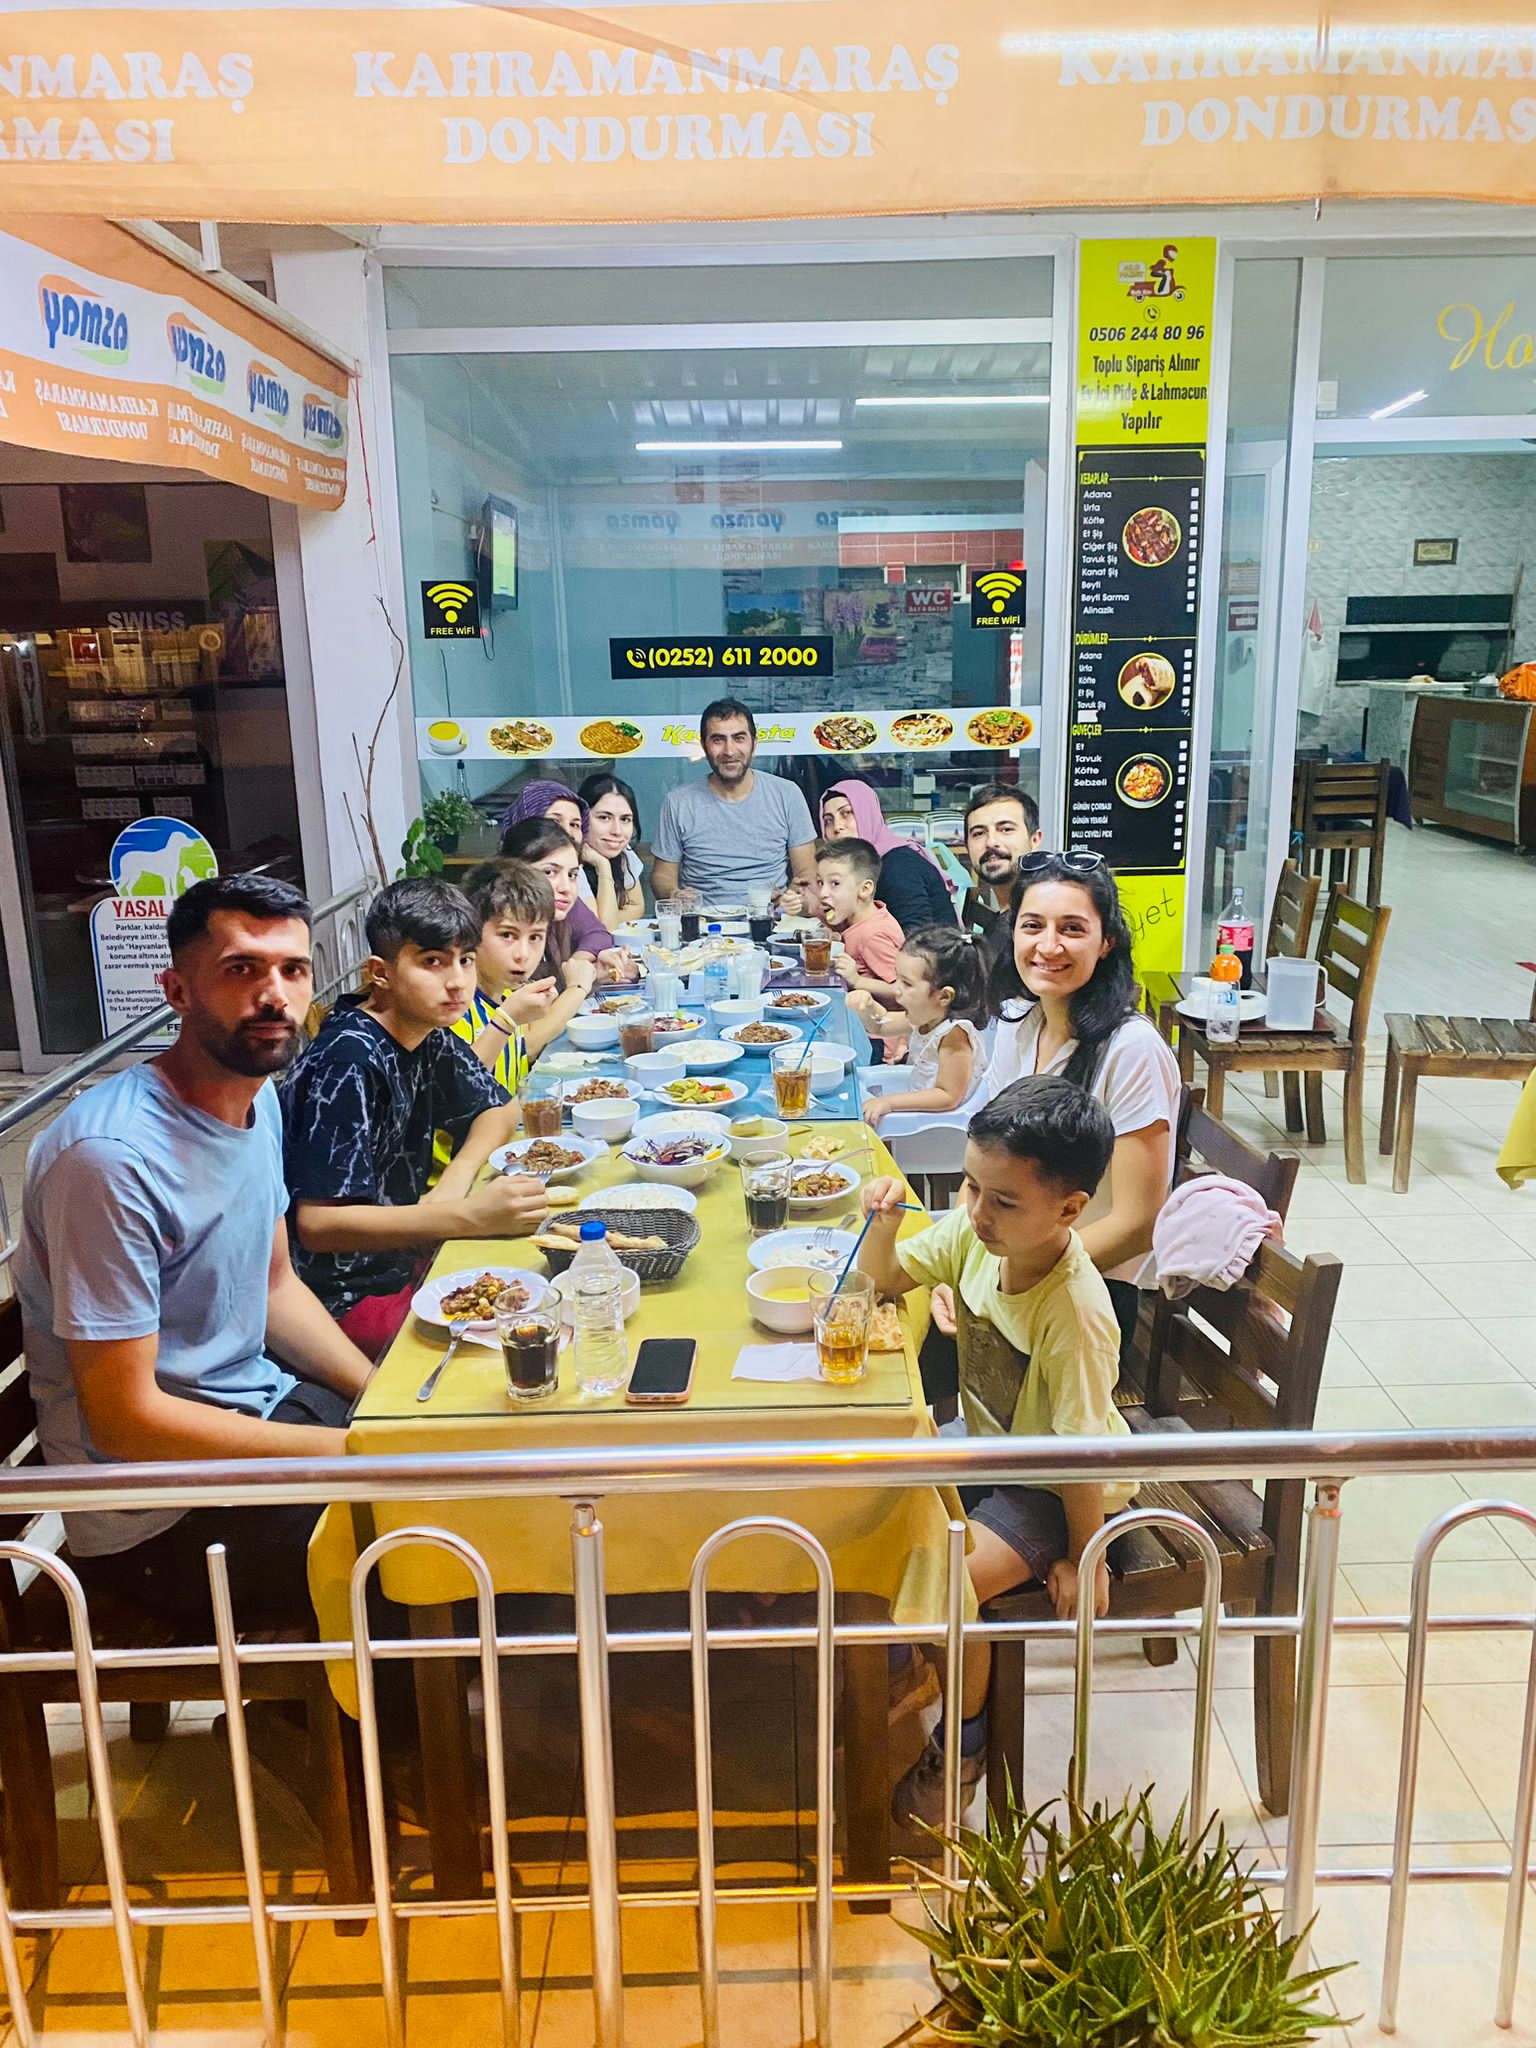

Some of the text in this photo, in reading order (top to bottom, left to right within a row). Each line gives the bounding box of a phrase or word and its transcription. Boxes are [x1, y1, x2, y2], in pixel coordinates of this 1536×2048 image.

[353, 45, 960, 107] KAHRAMANMARAŞ
[441, 112, 876, 164] DONDURMASI
[1089, 325, 1205, 342] 0506 244 80 96
[1092, 350, 1201, 377] Toplu Sipariş Alınır
[1140, 383, 1149, 400] &
[1150, 382, 1207, 401] Lahmacun
[1121, 411, 1162, 434] Yapılır
[1083, 491, 1112, 499] Adana
[1083, 504, 1100, 512] Urfa
[1083, 516, 1105, 525] Köfte
[1082, 555, 1105, 563] Tavuk
[1082, 568, 1106, 576] Kanat
[911, 591, 946, 606] WC
[1102, 593, 1129, 601] Sarma
[107, 611, 186, 631] SWISS
[976, 617, 1000, 625] FREE
[430, 627, 454, 636] FREE
[648, 646, 818, 669] (0252) 611 2000
[1079, 652, 1102, 660] Adana
[1079, 664, 1093, 672] Urfa
[1077, 701, 1096, 709] Tavuk
[1075, 743, 1085, 751] Et
[1075, 754, 1102, 763] Tavuk
[1074, 766, 1100, 775] Köfte
[111, 899, 169, 918] YASAL
